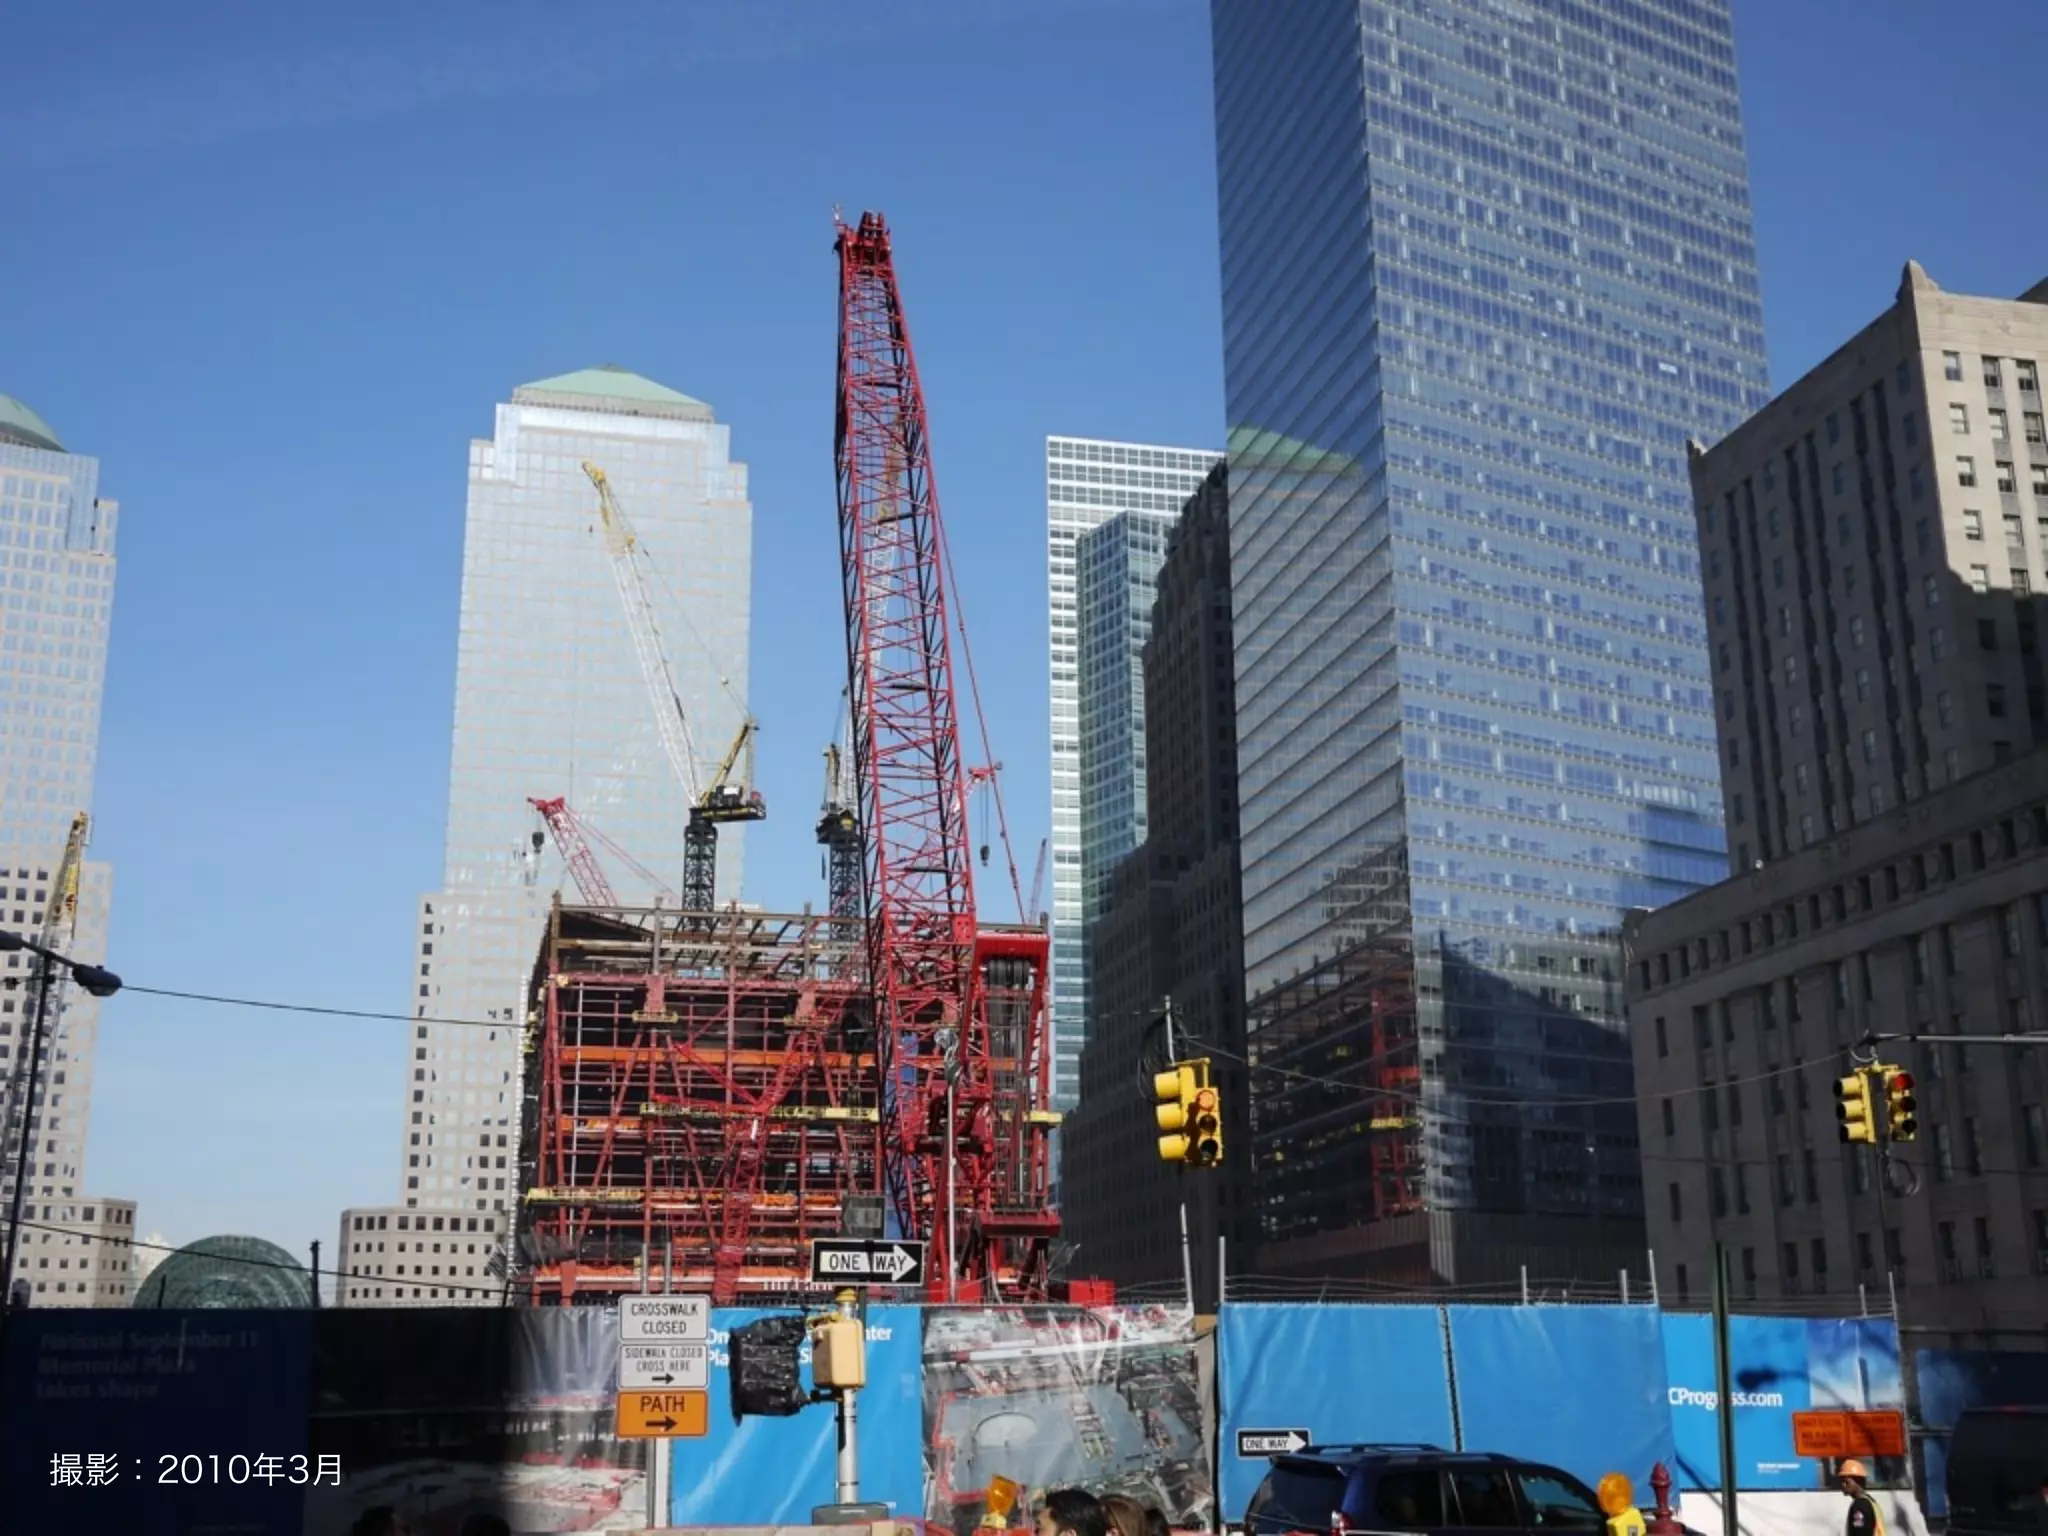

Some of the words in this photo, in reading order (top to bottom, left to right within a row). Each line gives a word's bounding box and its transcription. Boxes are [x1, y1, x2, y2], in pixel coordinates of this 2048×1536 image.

[829, 1253, 861, 1271] ONE
[874, 1254, 907, 1272] WAY
[631, 1303, 699, 1316] CROSSWALK
[641, 1320, 687, 1334] CLOSED
[625, 1347, 666, 1359] SIDEWALK
[670, 1347, 703, 1359] CLOSED
[636, 1360, 665, 1373] CROSS
[669, 1360, 691, 1373] HERE
[640, 1396, 685, 1413] PATH
[1246, 1438, 1264, 1449] ONE
[1268, 1438, 1288, 1449] WAY
